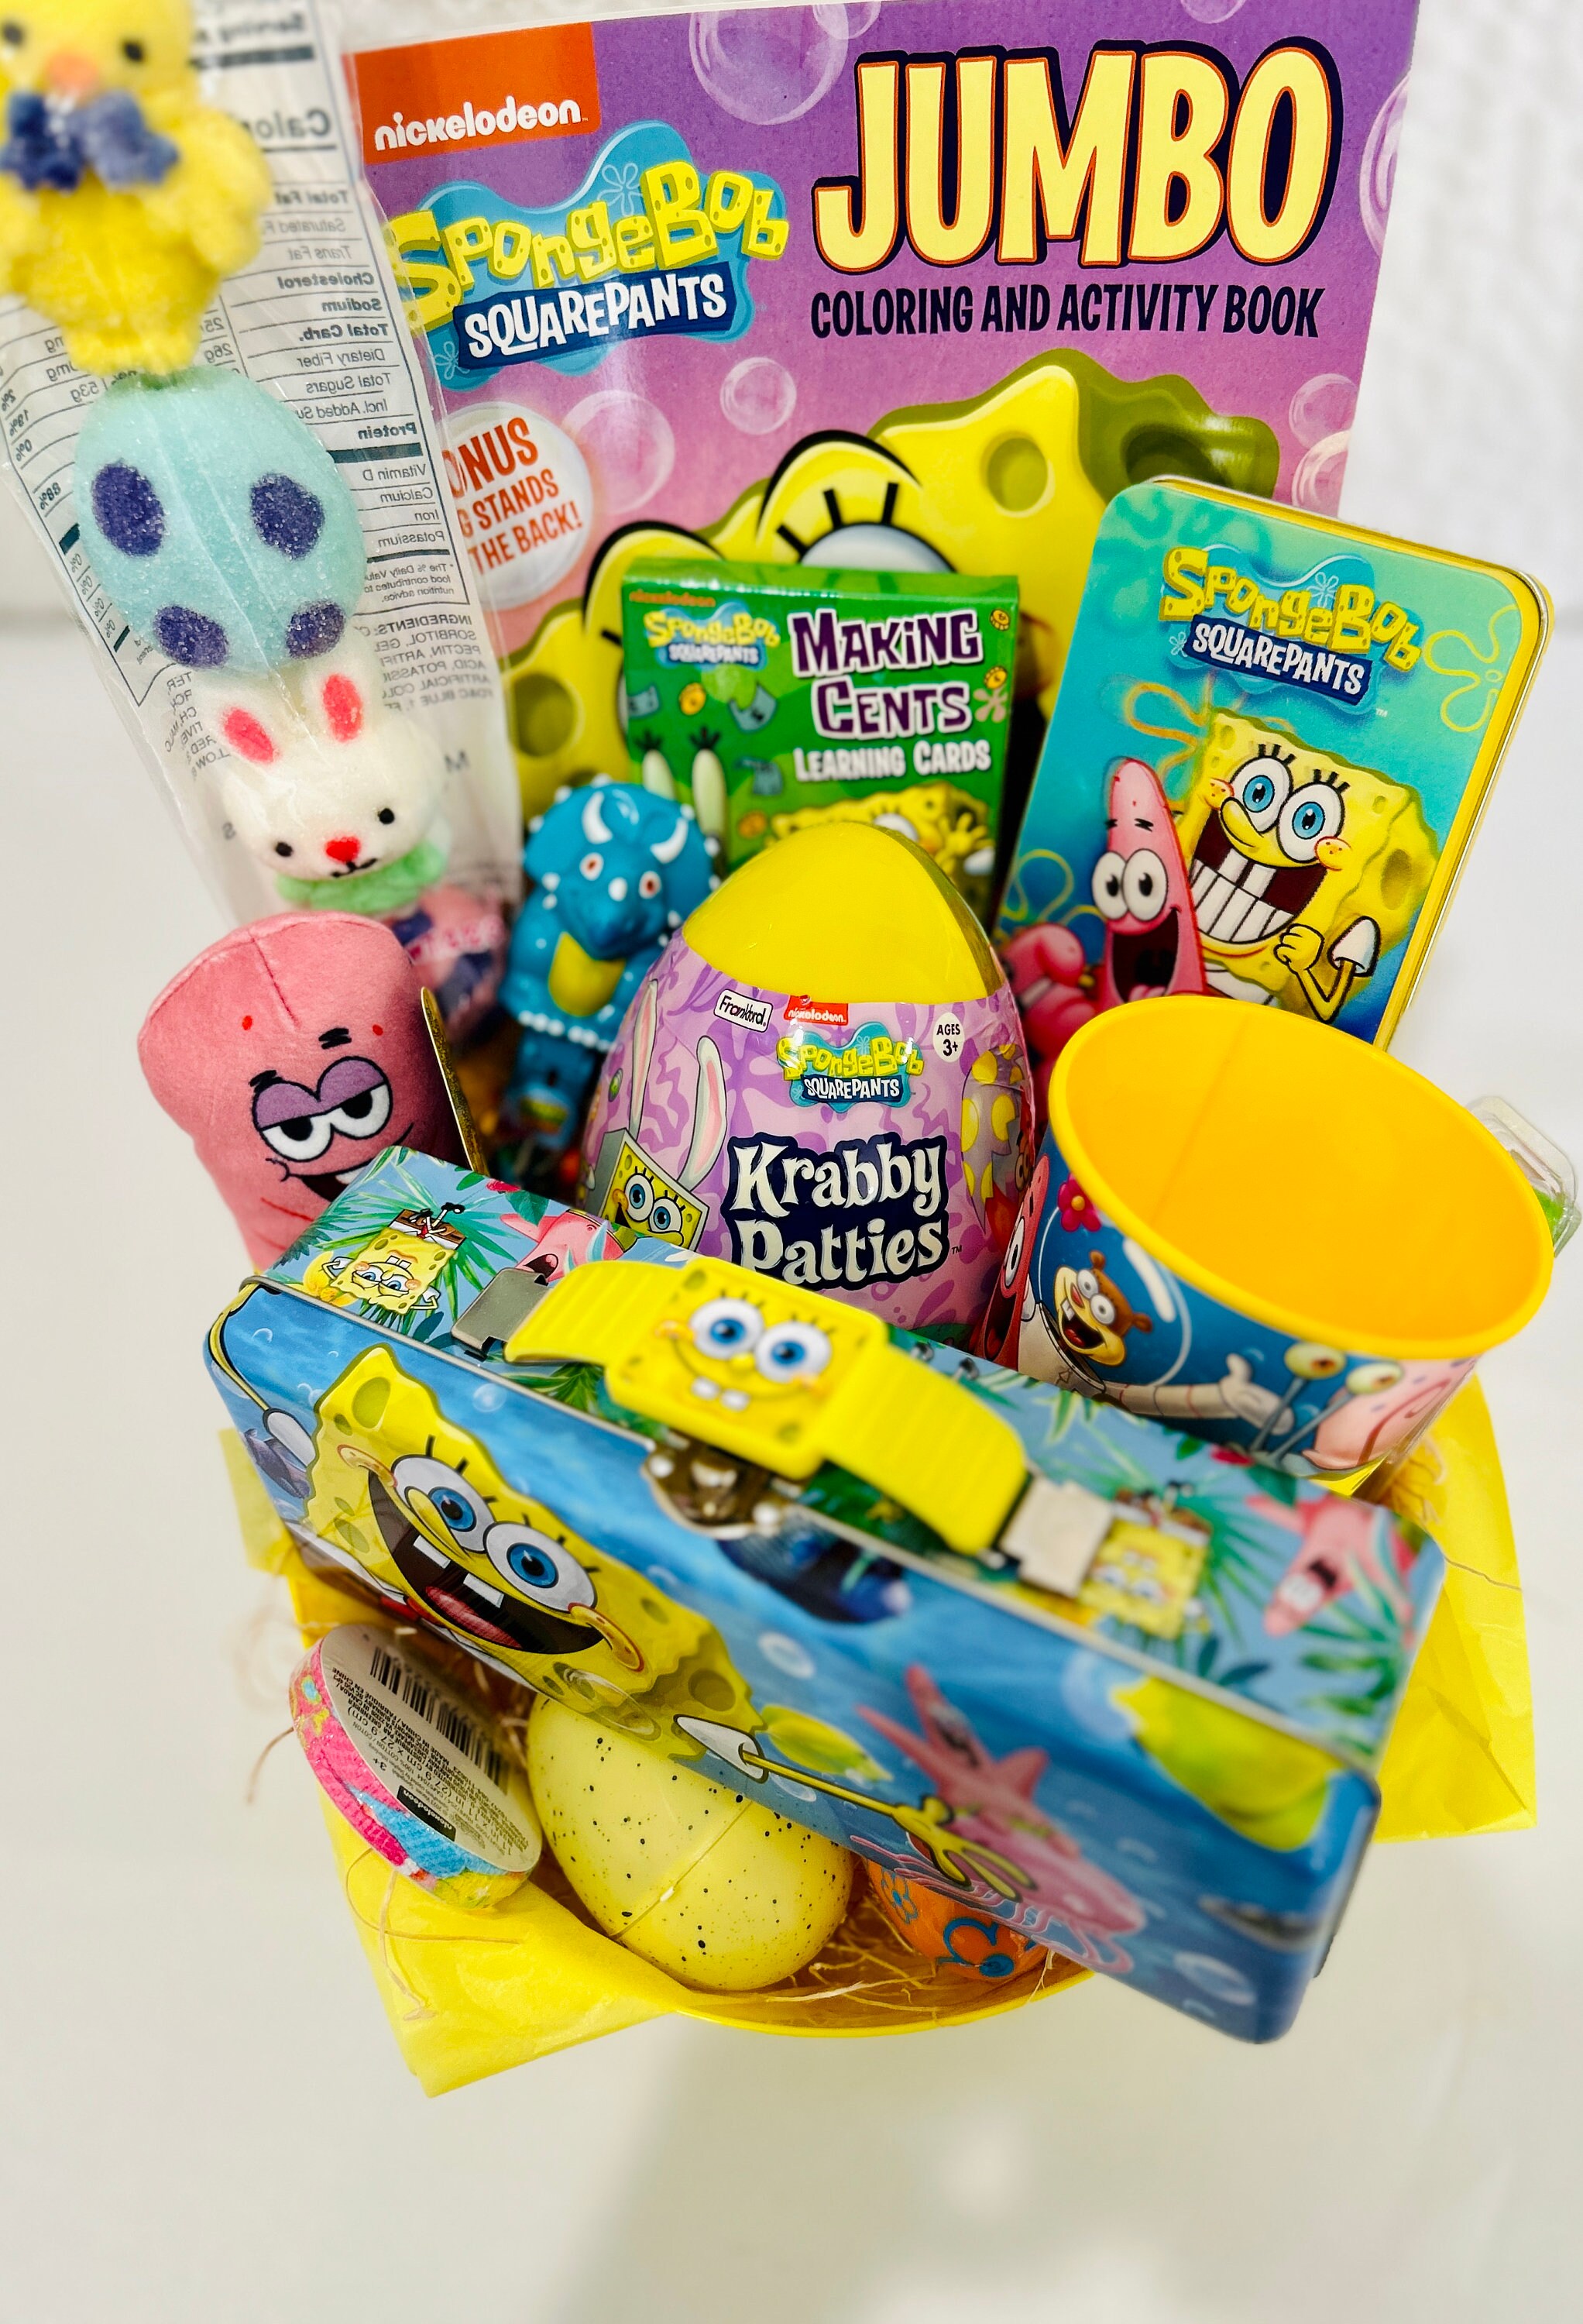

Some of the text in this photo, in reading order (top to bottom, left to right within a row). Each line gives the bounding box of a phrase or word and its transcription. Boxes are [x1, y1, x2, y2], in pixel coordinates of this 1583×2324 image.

[376, 96, 581, 150] nickelodeon
[812, 42, 1338, 273] JUMBO
[384, 160, 789, 336] SpongeBob
[465, 273, 726, 358] SQUAREPANTS
[811, 284, 1325, 339] COLORING AND ACTIVITY BOOK
[441, 417, 538, 498] ONUS
[472, 468, 559, 530] STANDS
[468, 532, 515, 576] THE
[512, 500, 582, 555] BACK!
[1159, 546, 1423, 672] SpongeBob
[644, 611, 781, 648] SpongeBob
[668, 644, 759, 664] SQUAREPANTS
[1193, 622, 1366, 698] SQUAREPANTS
[813, 676, 971, 739] CENTS
[794, 740, 992, 782] LEARNING CARDS
[936, 1023, 960, 1036] AGES
[777, 1037, 924, 1080] SpongeBob
[943, 1039, 959, 1057] 3+
[805, 1078, 900, 1098] SQUAREPANTS
[730, 1142, 943, 1219] Krabby
[734, 1217, 943, 1286] Patties
[331, 1665, 353, 1686] CHINE
[354, 1682, 364, 1694] EN
[339, 1684, 362, 1707] CANADA
[347, 1704, 368, 1730] cm)
[348, 1697, 381, 1729] GREENBRIER
[352, 1721, 372, 1740] COTON
[370, 1724, 394, 1751] 27.9
[400, 1720, 421, 1742] CHINA
[422, 1738, 429, 1749] IN
[372, 1754, 386, 1772] 3+
[376, 1739, 398, 1762] COTTON
[397, 1746, 403, 1756] x
[407, 1754, 422, 1772] cm
[430, 1745, 449, 1766] MADE
[424, 1769, 452, 1798] (27.9
[402, 1788, 452, 1831] nickelodeon
